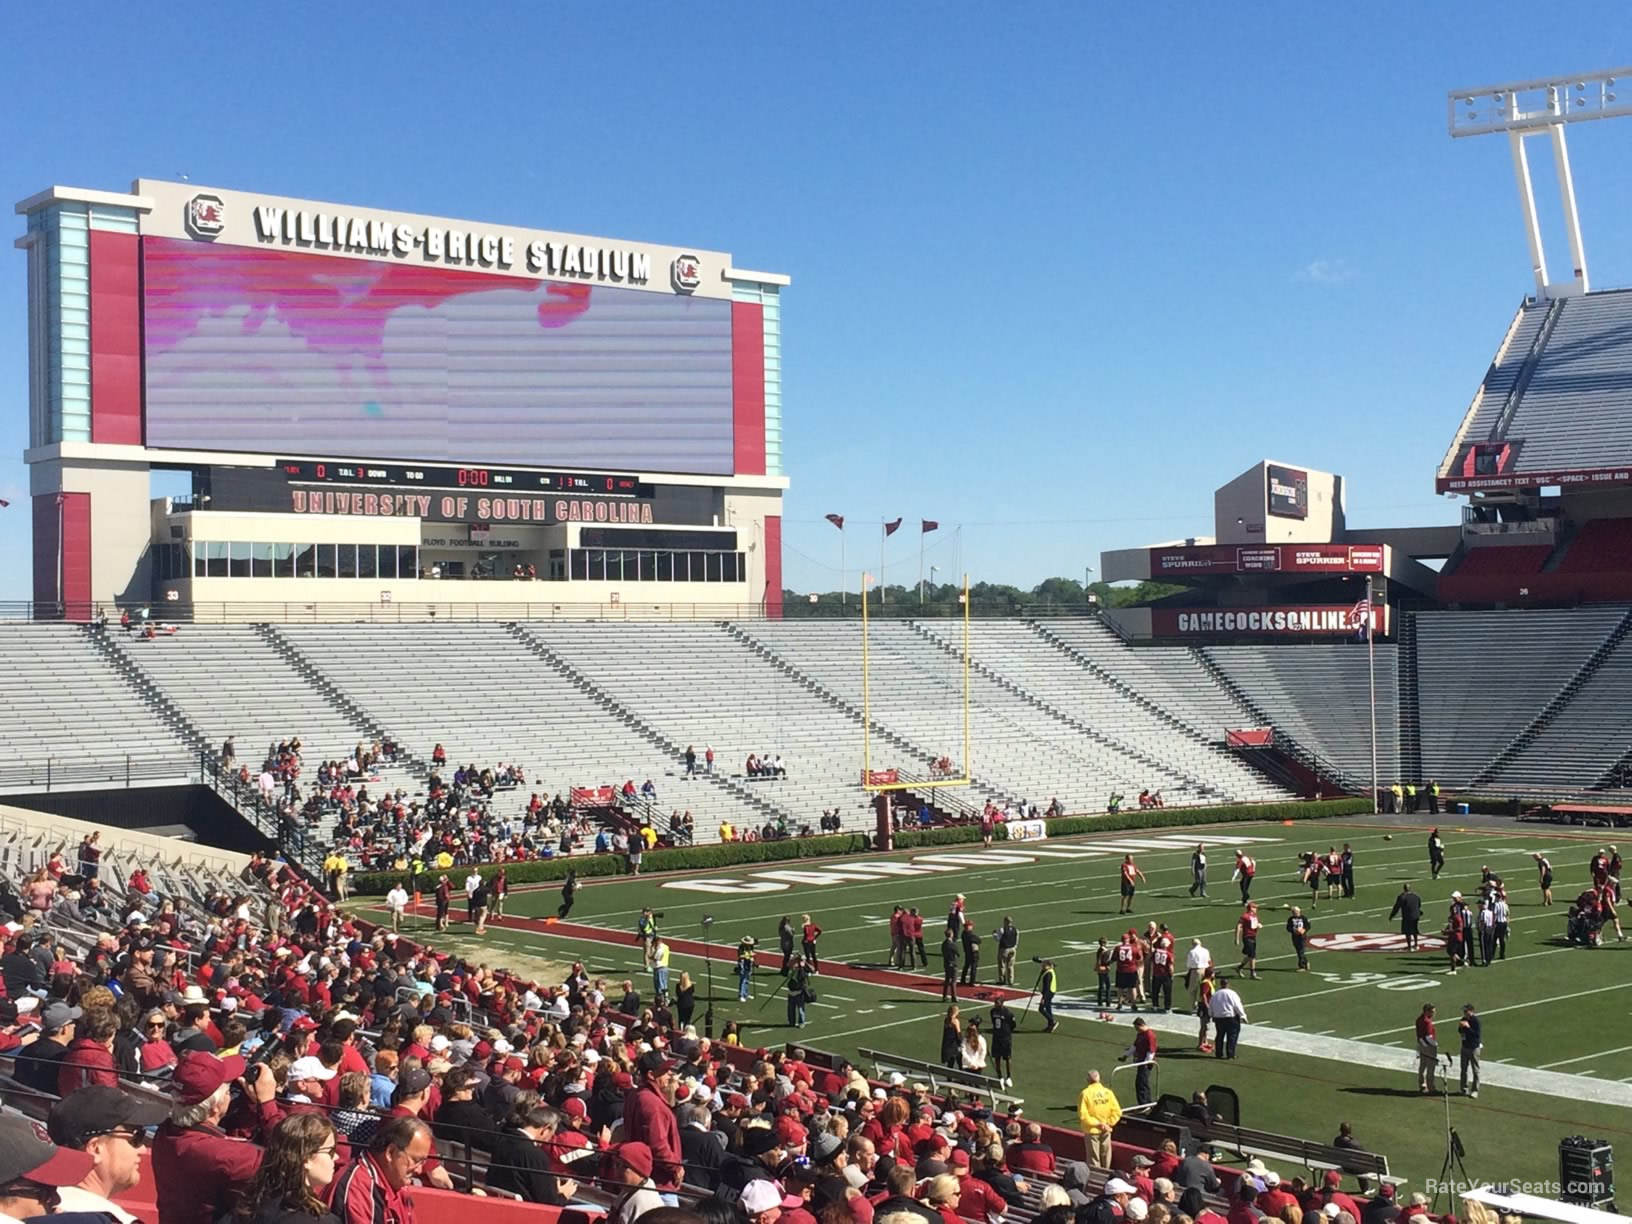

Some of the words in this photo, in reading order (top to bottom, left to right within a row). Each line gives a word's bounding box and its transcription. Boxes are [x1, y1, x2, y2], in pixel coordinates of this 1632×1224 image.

[528, 240, 650, 282] STADIUM
[317, 465, 325, 478] 0
[406, 471, 415, 479] TO
[459, 469, 488, 485] 0:00
[606, 478, 613, 490] 0
[1450, 481, 1466, 489] NEED
[1468, 479, 1512, 488] ASSISTANCE?
[1556, 475, 1590, 483] <SPACE>
[1591, 473, 1612, 481] ISSUE
[1614, 472, 1629, 480] AND
[292, 491, 431, 517] UNIVERSITY
[441, 497, 468, 518] OF
[478, 498, 545, 520] SOUTH
[555, 500, 654, 523] CAROLINA
[423, 538, 446, 546] FLOYD
[449, 539, 484, 547] FOOTBALL
[489, 540, 519, 548] BUILDING
[661, 834, 1285, 893] CAROLINA
[1119, 949, 1132, 961] 64
